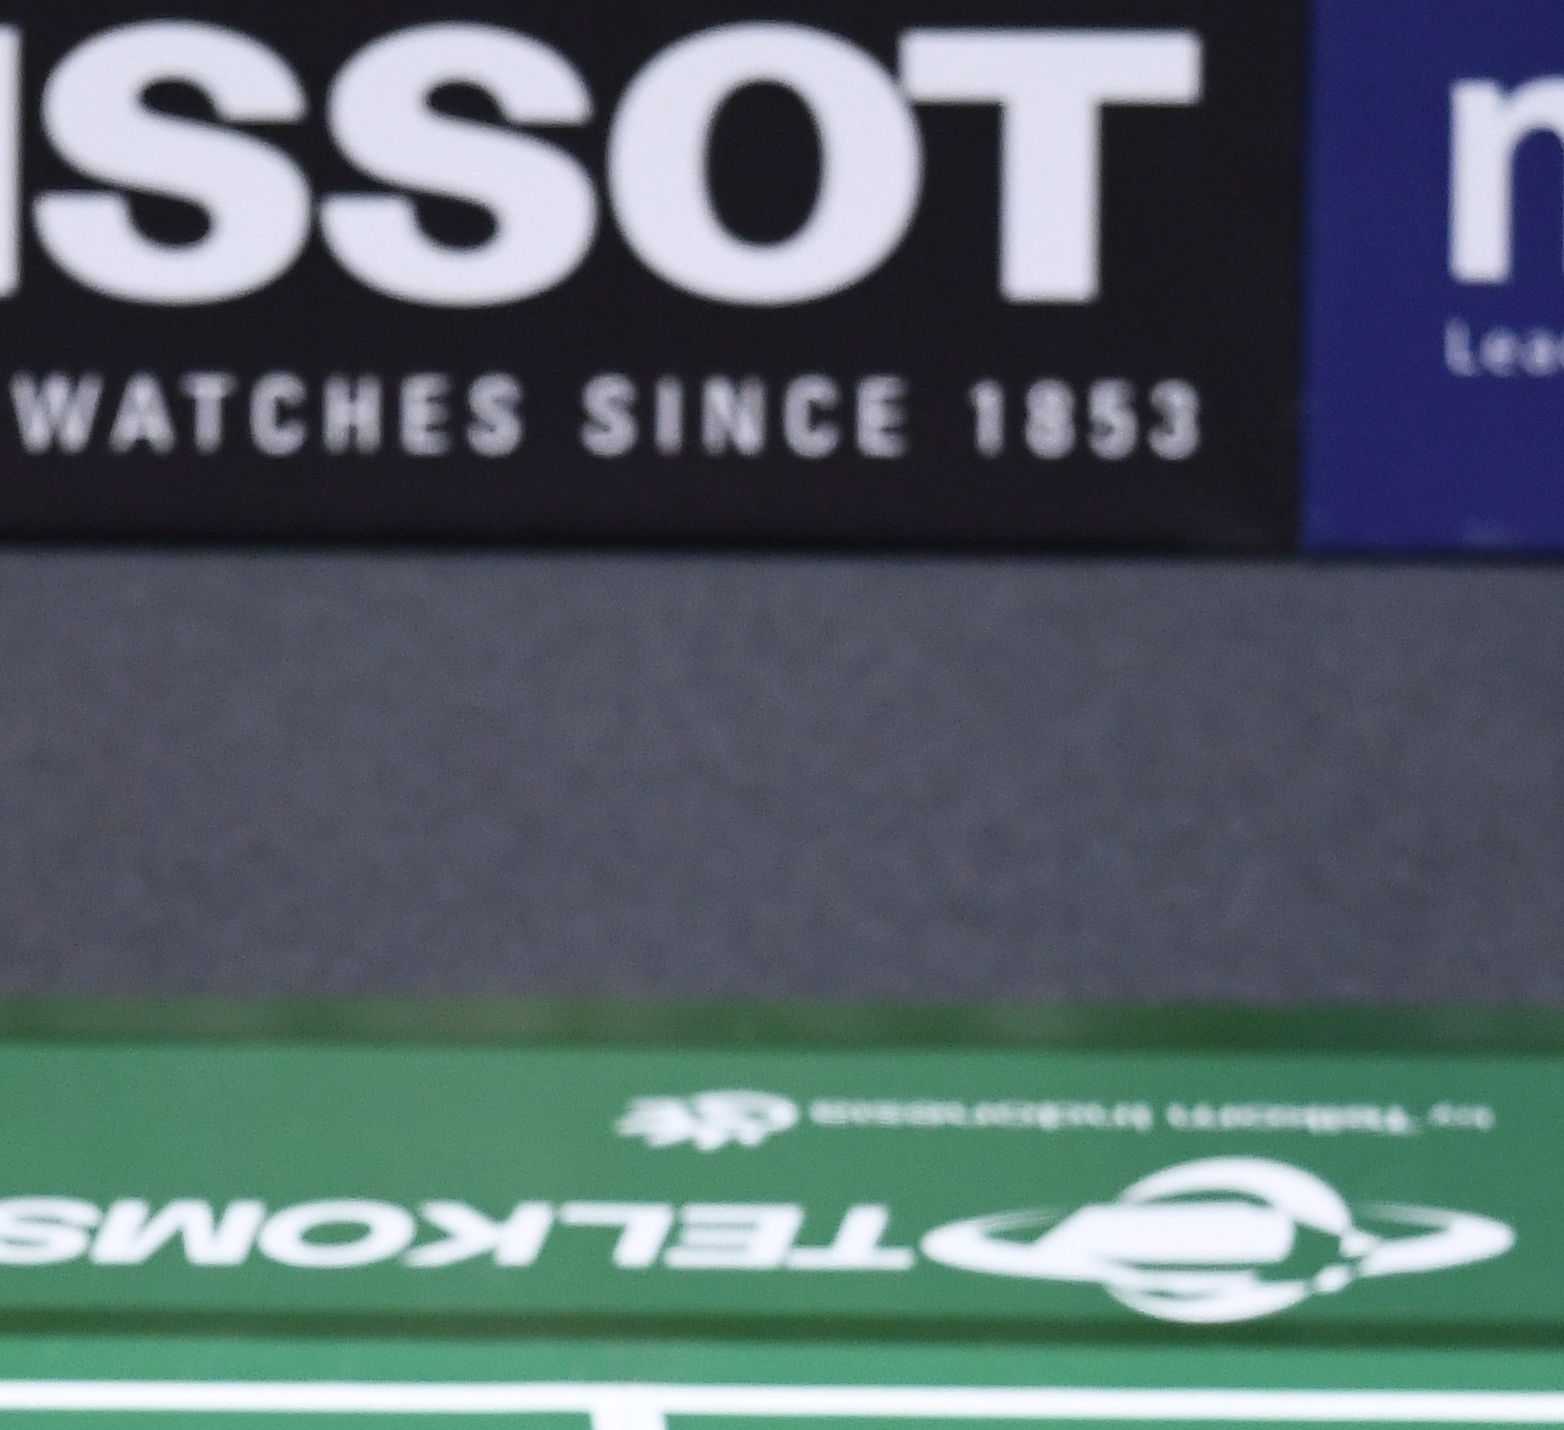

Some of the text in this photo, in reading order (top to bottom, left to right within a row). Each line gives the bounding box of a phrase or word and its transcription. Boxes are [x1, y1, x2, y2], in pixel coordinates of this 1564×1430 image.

[10, 372, 524, 458] WATCHES
[582, 374, 904, 460] SINCE
[971, 378, 1201, 462] 1853
